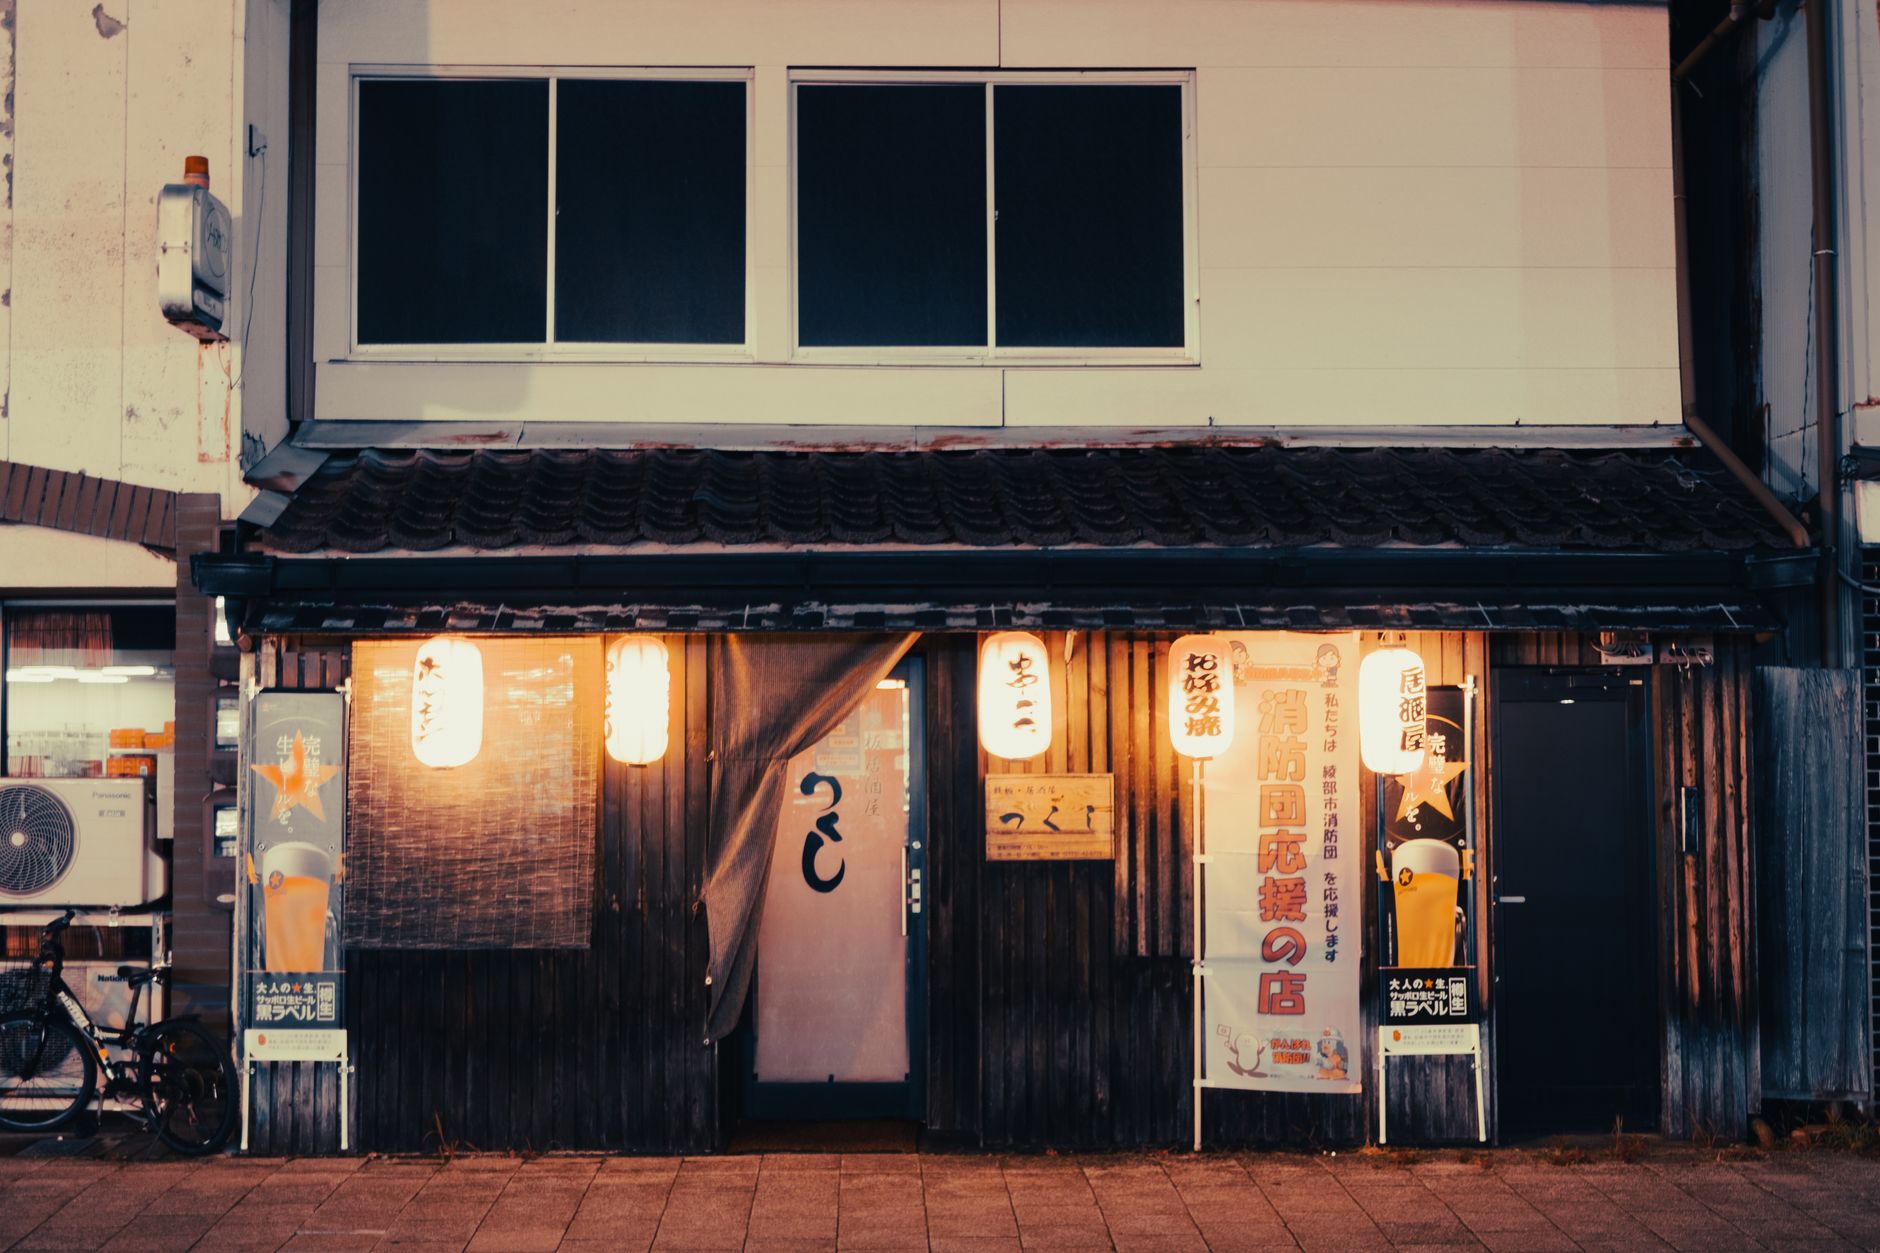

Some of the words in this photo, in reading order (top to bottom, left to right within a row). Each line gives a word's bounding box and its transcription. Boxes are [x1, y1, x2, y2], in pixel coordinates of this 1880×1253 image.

[1183, 653, 1222, 737] お好み焼
[1322, 692, 1339, 753] 私たちは
[1398, 666, 1425, 752] 居酒屋
[1427, 731, 1446, 795] 完璧な
[92, 791, 132, 799] Panasonic
[1322, 765, 1338, 859] 綾部市消防団
[800, 771, 846, 893] つくし
[1256, 688, 1308, 1016] 消防団応援の店
[1323, 871, 1339, 963] を応援します
[98, 974, 129, 983] Nation
[256, 995, 316, 1005] サッポロ生ビール
[1390, 991, 1449, 1001] サッポロ生ビール
[1390, 1000, 1449, 1017] 黒ラベル
[256, 1004, 316, 1021] 黒ラベル
